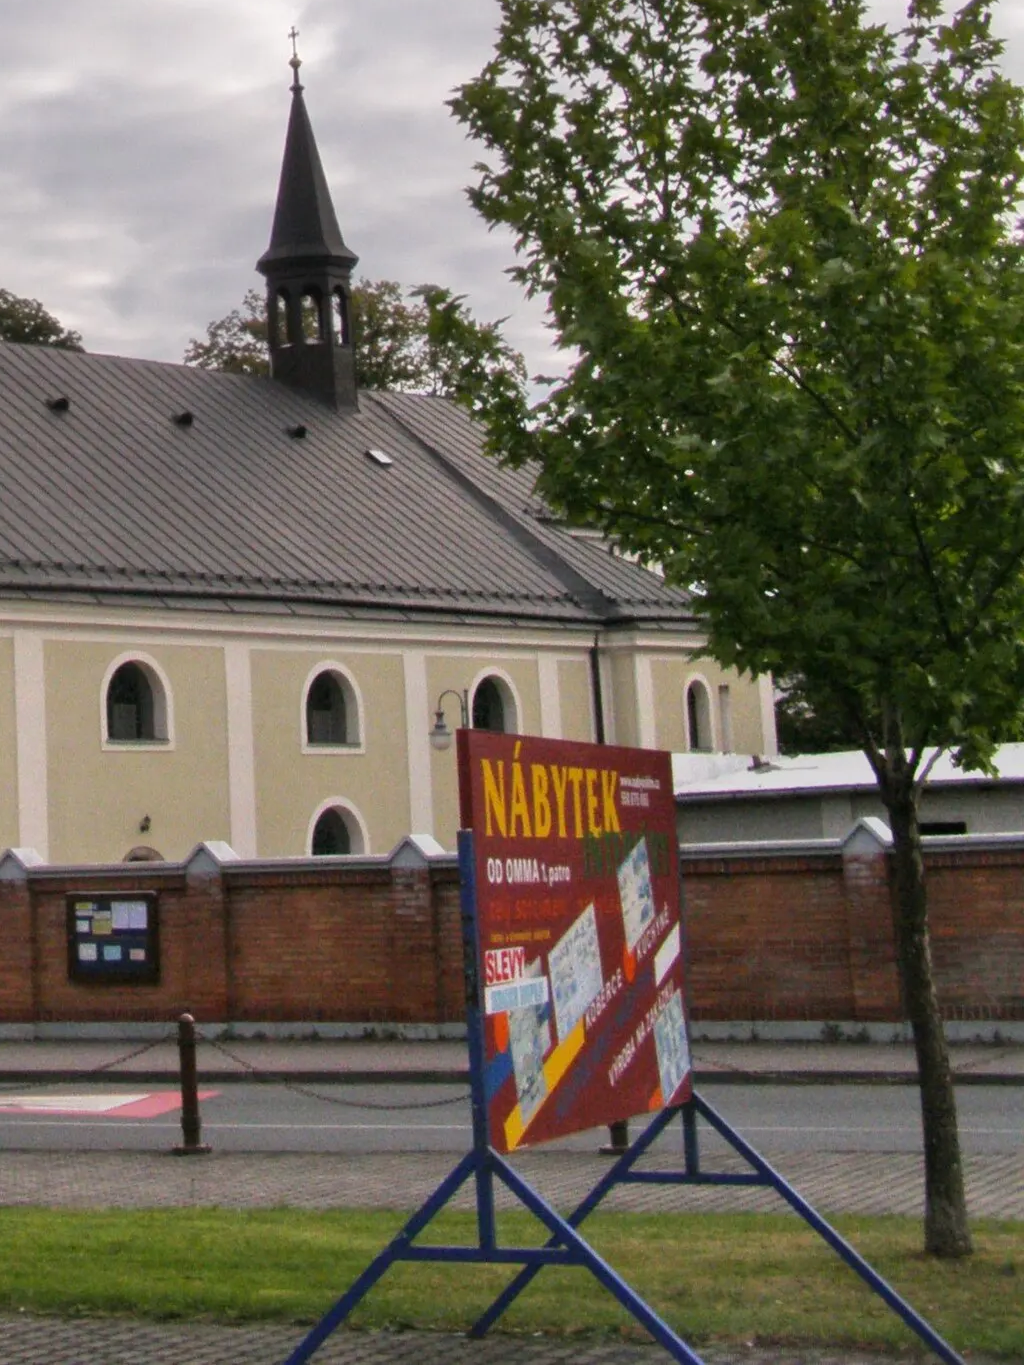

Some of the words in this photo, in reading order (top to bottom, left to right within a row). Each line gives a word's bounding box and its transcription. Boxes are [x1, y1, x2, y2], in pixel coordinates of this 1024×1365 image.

[481, 740, 622, 839] NÁBYTEK
[487, 858, 503, 884] OD
[506, 858, 540, 884] OMMA
[548, 864, 571, 886] patro
[484, 948, 524, 984] SLEVY
[585, 967, 624, 1028] KOBERCE
